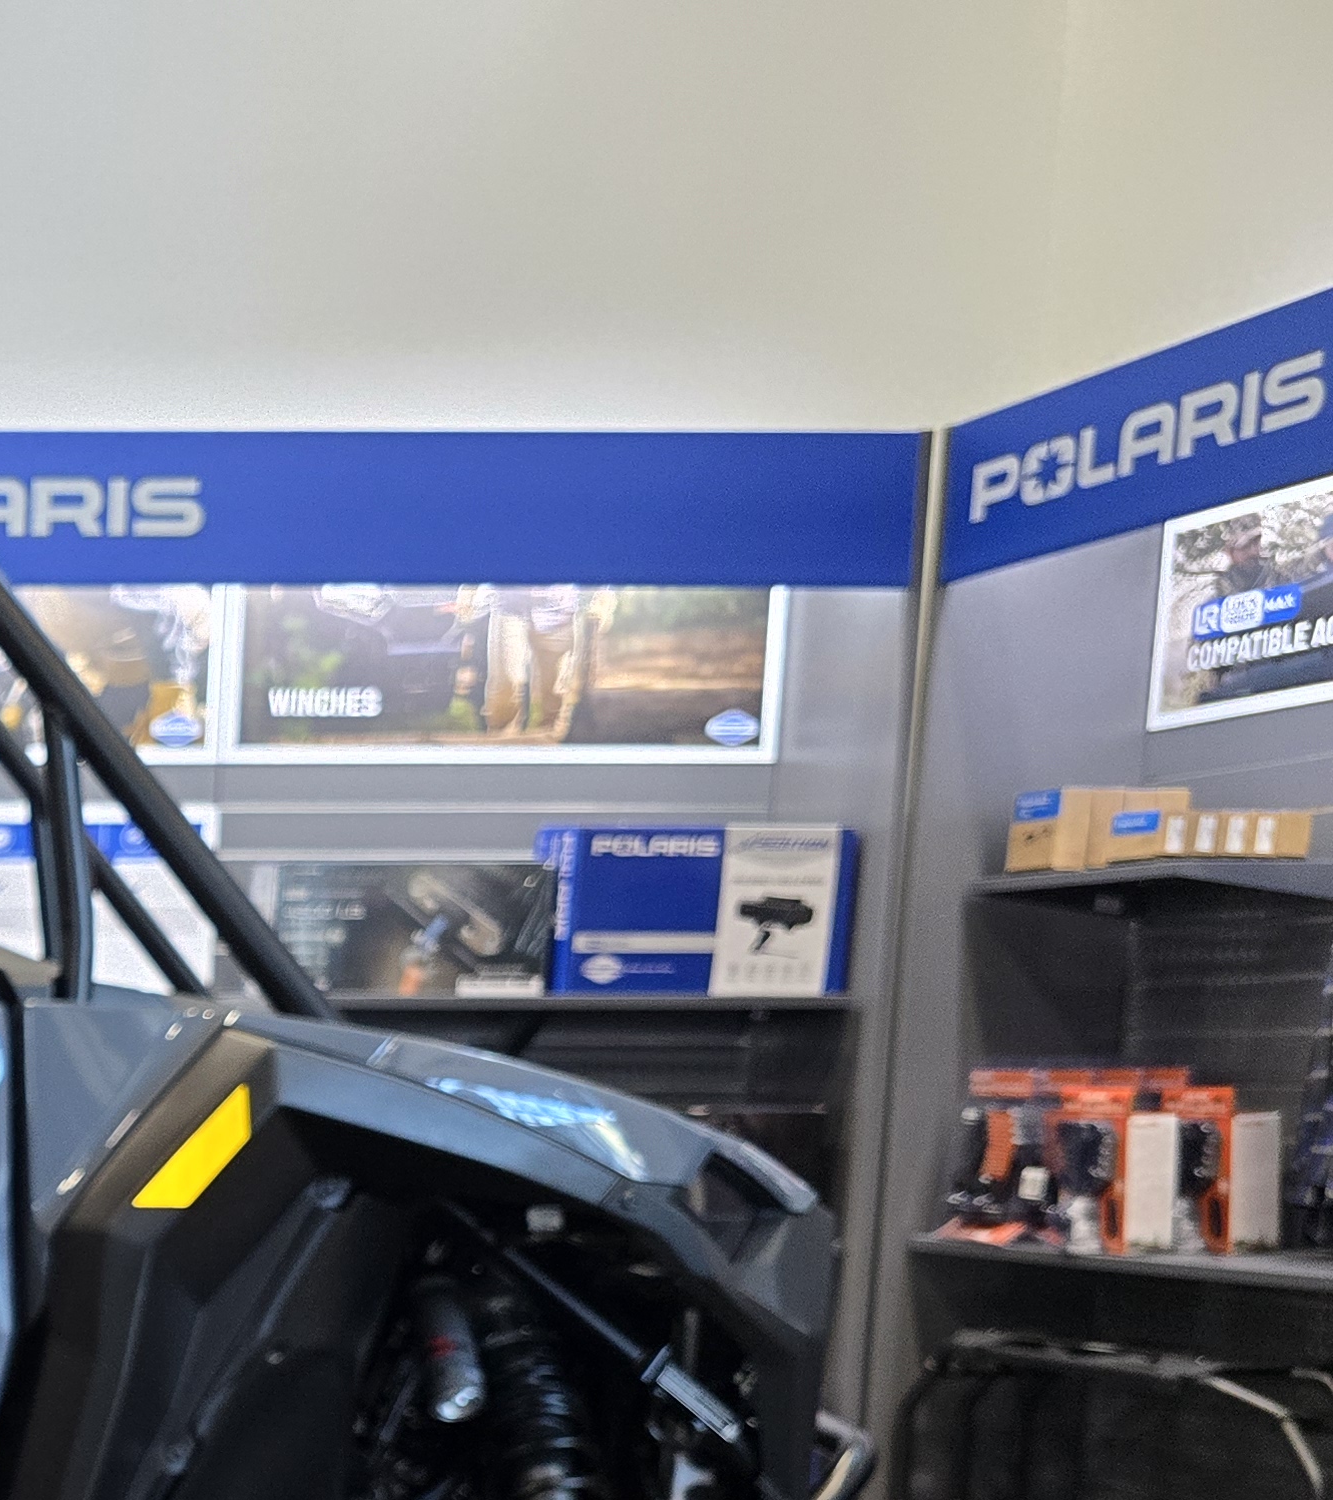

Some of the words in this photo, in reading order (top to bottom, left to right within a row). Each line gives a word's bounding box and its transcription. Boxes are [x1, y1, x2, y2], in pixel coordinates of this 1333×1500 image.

[968, 349, 1326, 524] POLARIS
[1187, 619, 1312, 672] COMPATIBLE
[268, 685, 383, 717] WINCHES
[590, 834, 722, 857] POLARIS
